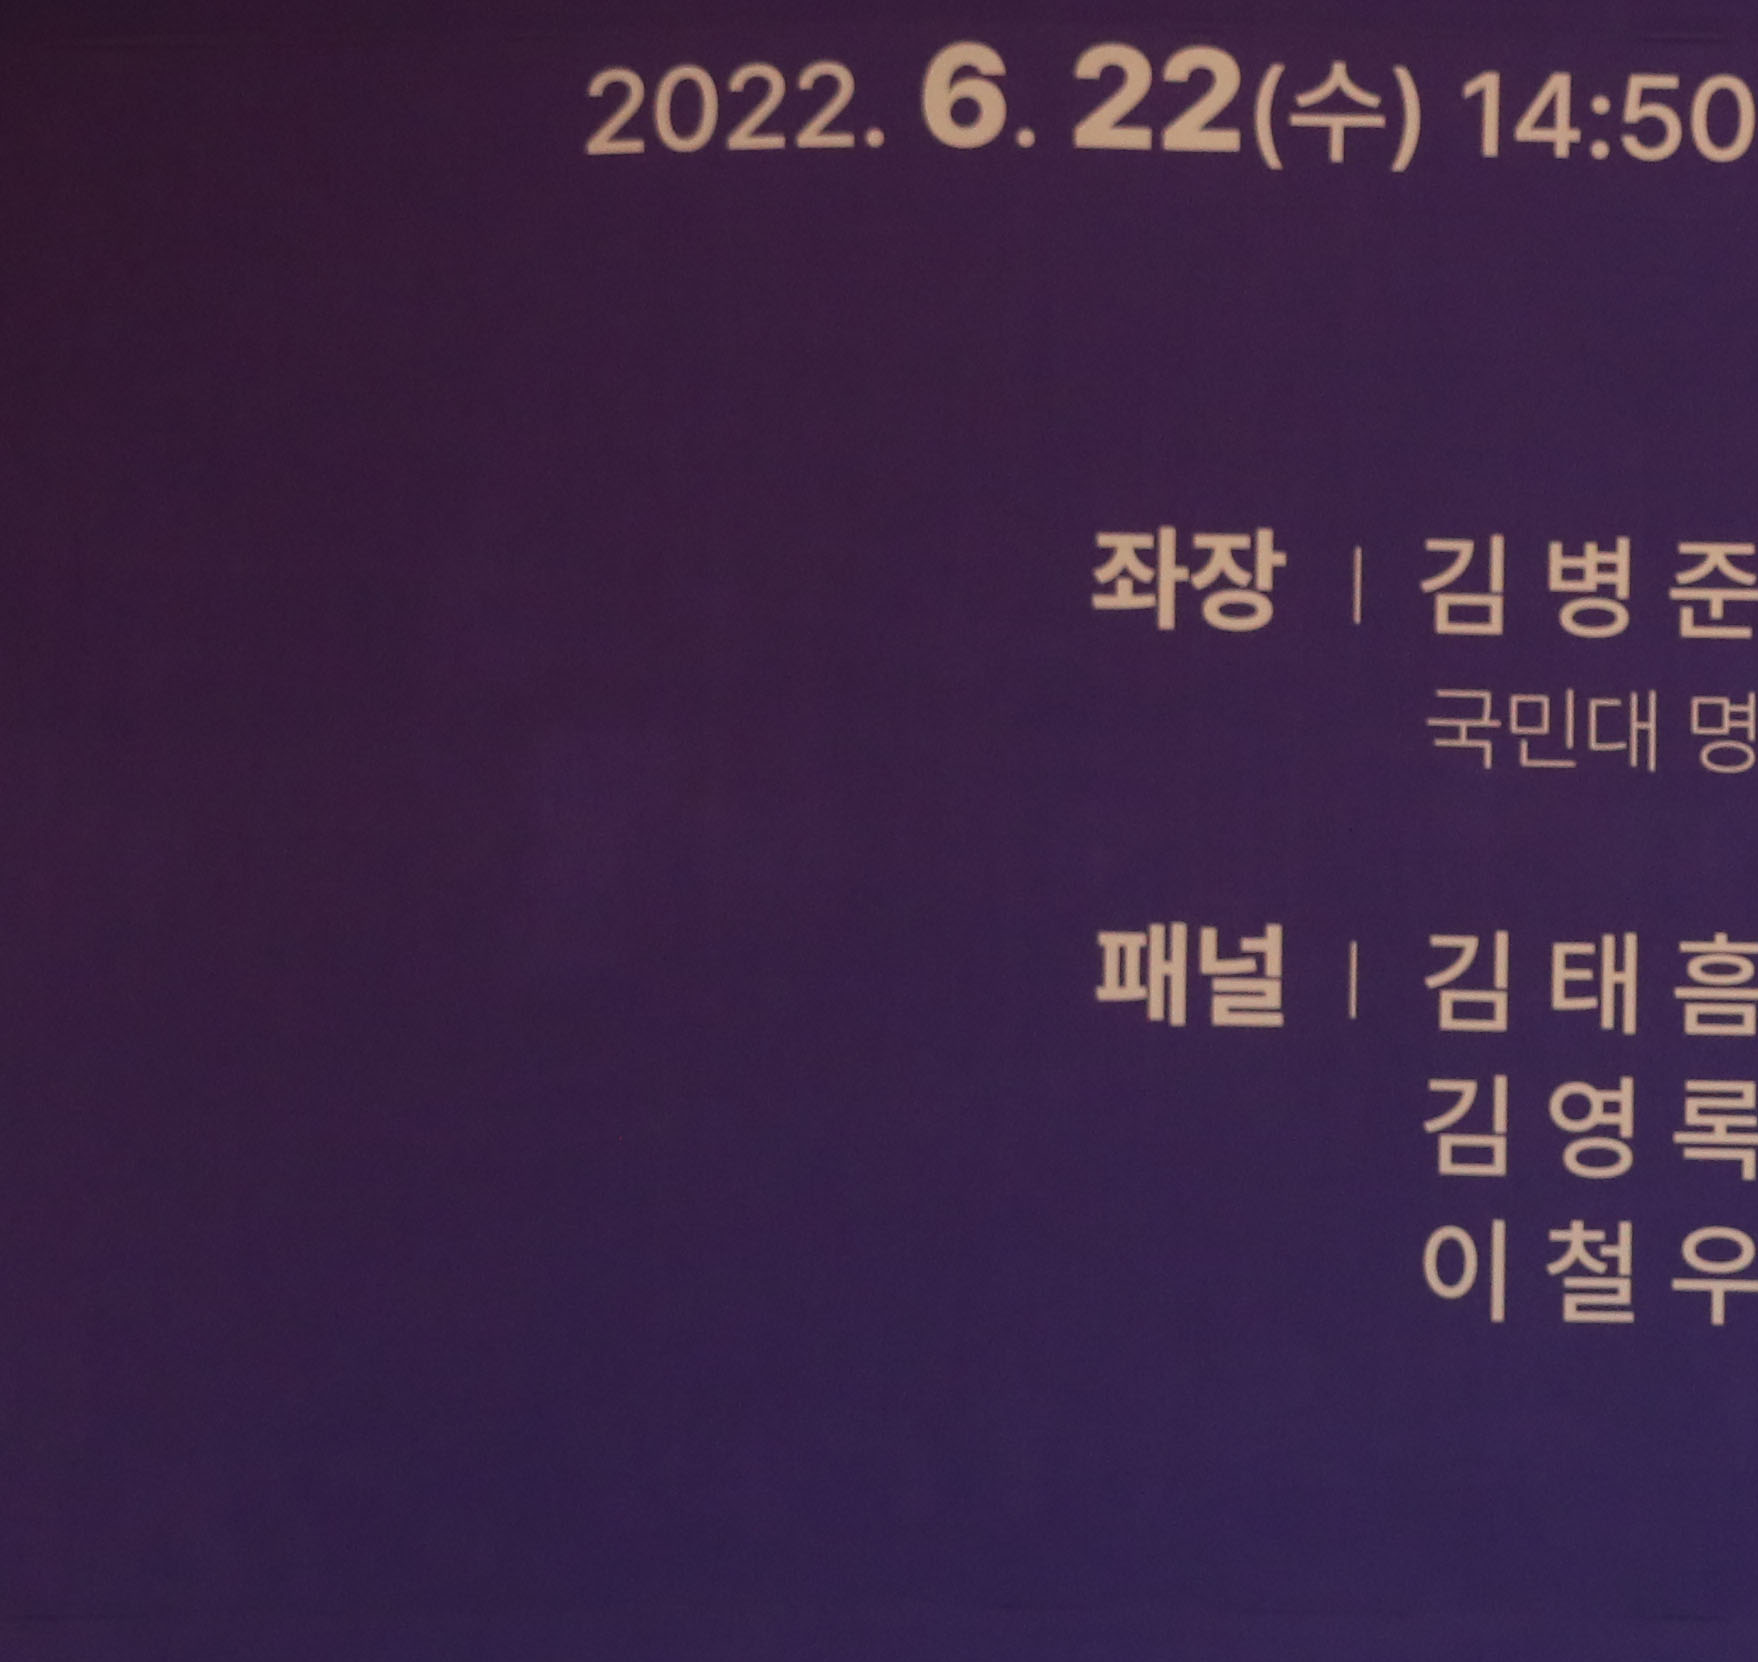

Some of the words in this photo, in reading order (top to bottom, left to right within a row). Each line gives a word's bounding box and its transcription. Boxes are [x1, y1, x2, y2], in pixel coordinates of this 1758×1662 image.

[586, 61, 884, 155] 2022.
[921, 41, 1035, 148] 6.
[1073, 42, 1420, 172] 22(수)
[1092, 526, 1287, 632] 좌장
[1427, 689, 1656, 772] 국민대
[1095, 922, 1284, 1027] 패널
